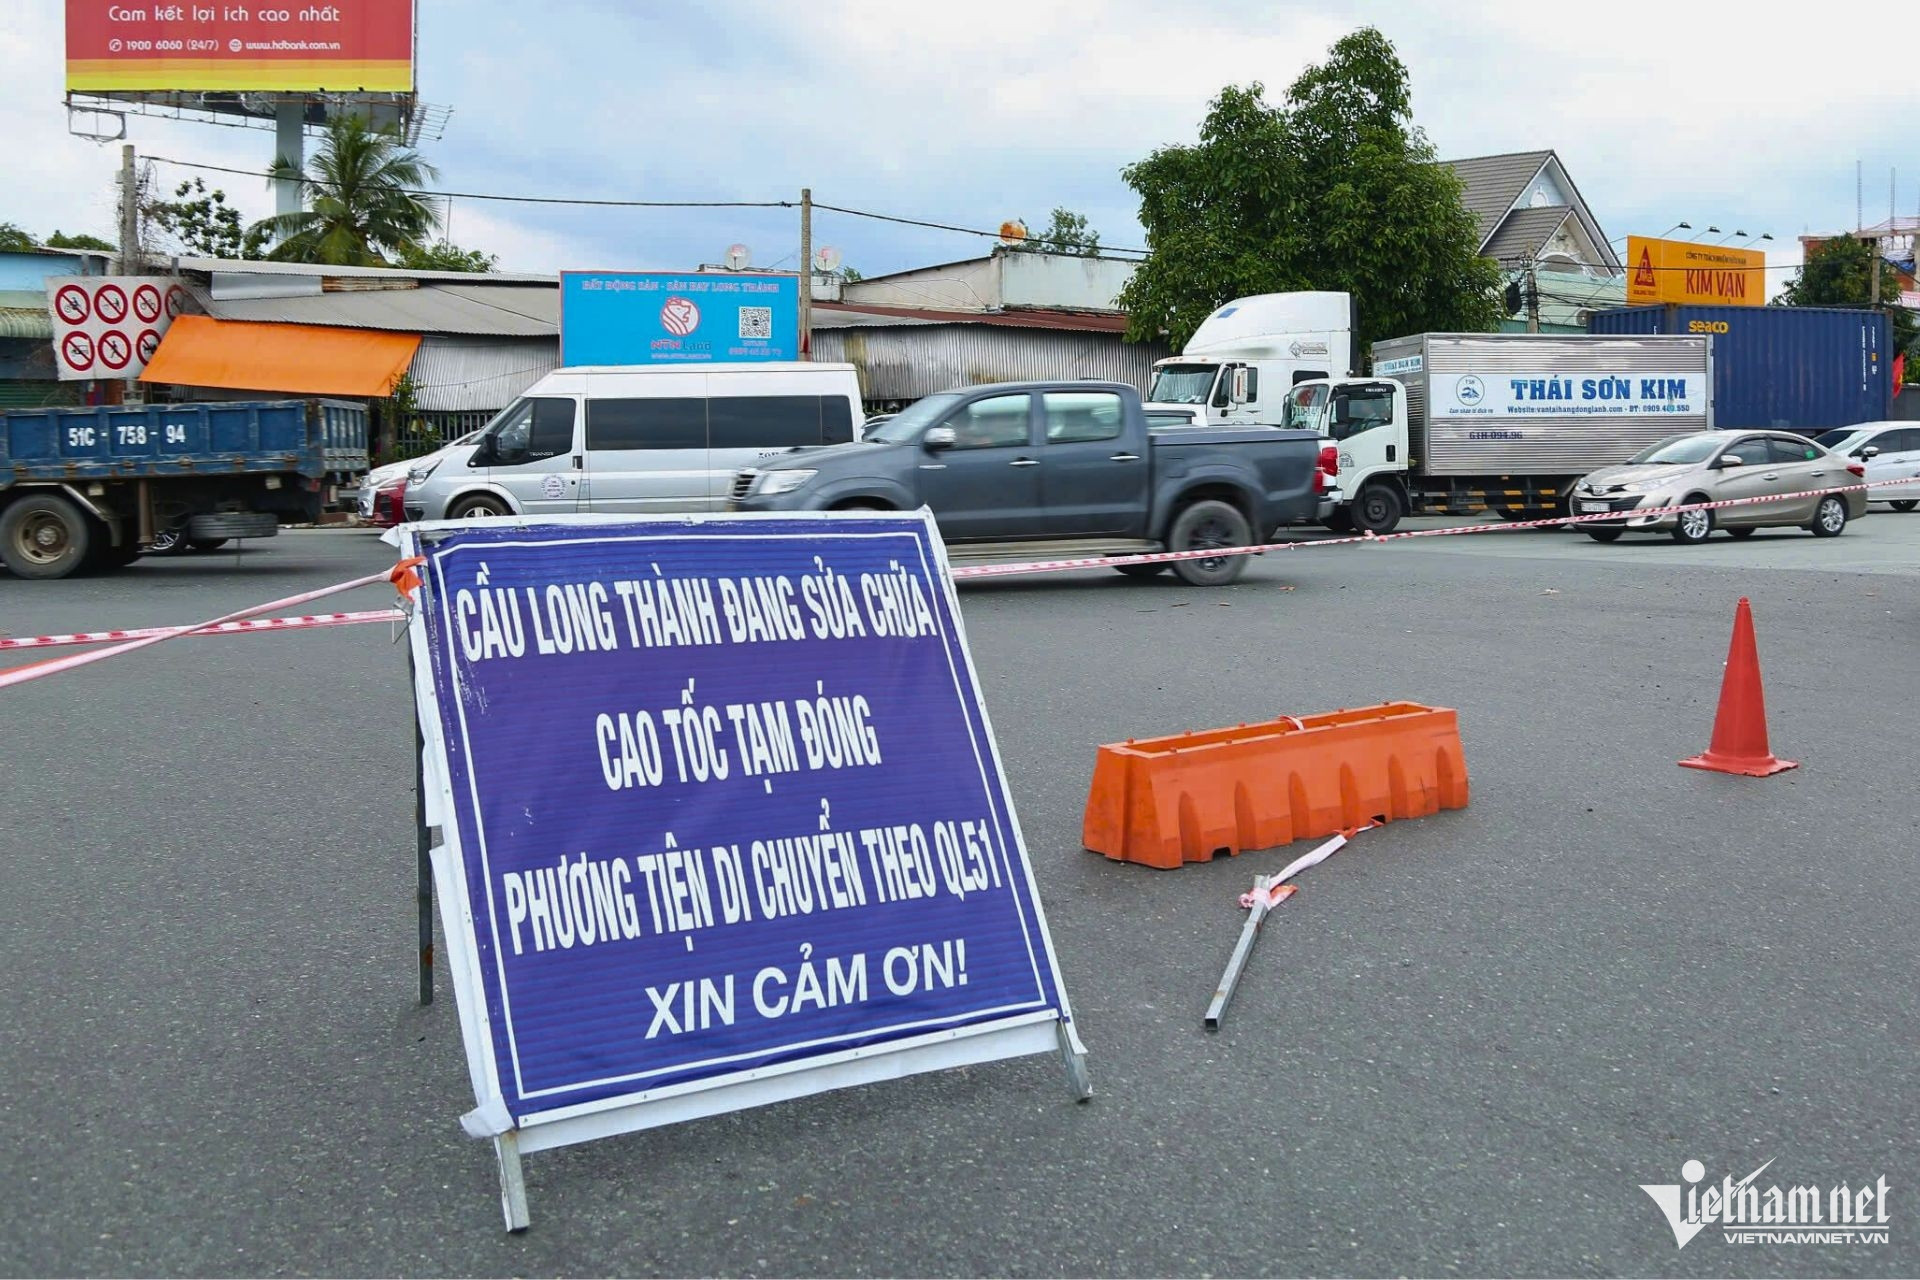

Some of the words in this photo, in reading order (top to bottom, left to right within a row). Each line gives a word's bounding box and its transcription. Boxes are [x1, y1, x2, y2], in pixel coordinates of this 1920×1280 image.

[109, 6, 146, 21] Cam
[155, 6, 184, 21] kết
[192, 6, 215, 24] lợi
[224, 6, 249, 21] ích
[258, 10, 290, 21] cao
[298, 5, 341, 21] nhất
[126, 40, 151, 50] 1900
[156, 40, 183, 50] 6060
[186, 39, 219, 51] (24/7)
[246, 39, 341, 50] www.hdbank.com.vn
[1686, 269, 1713, 296] KIM
[1688, 319, 1729, 334] seaco
[1510, 375, 1573, 400] THÁI
[1582, 375, 1631, 400] SƠN
[1640, 379, 1686, 399] KIM
[68, 426, 95, 447] 51C
[117, 425, 147, 445] 758
[165, 424, 186, 443] 94
[455, 562, 525, 661] CẦU
[527, 582, 618, 655] LONG
[614, 563, 722, 647] THÀNH
[717, 576, 806, 643] ĐANG
[801, 555, 867, 638] SỬA
[860, 560, 938, 638] CHỮA
[596, 710, 663, 791] CAO
[662, 678, 729, 783] TỐC
[726, 701, 800, 794] TẠM
[795, 680, 882, 770] ĐÓNG
[504, 852, 640, 955] PHƯƠNG
[637, 832, 715, 951] TIỆN
[711, 844, 752, 924] DI
[751, 798, 867, 920] CHUYỂN
[860, 824, 936, 902] THEO
[933, 819, 1002, 901] QL51
[645, 975, 735, 1040] XIN
[752, 942, 868, 1019] CẢM
[883, 938, 969, 996] ƠN!
